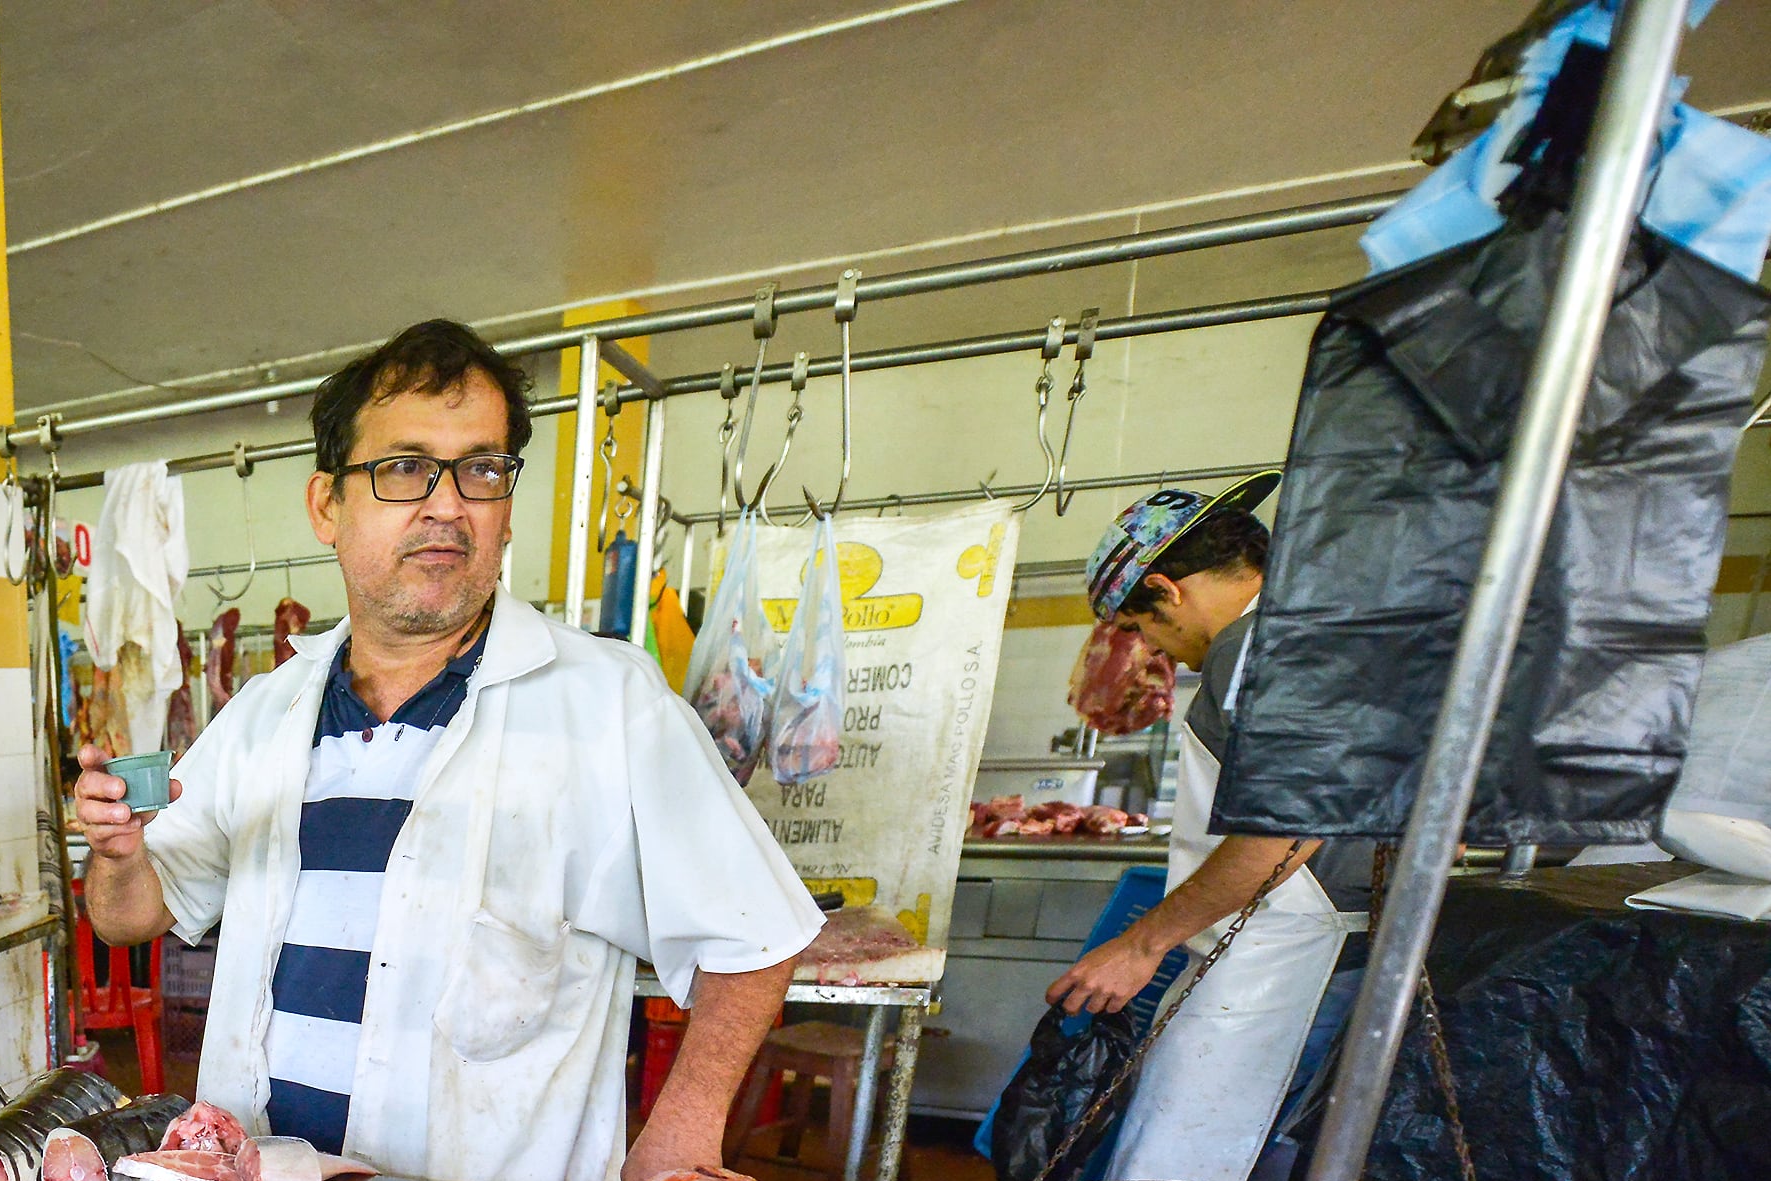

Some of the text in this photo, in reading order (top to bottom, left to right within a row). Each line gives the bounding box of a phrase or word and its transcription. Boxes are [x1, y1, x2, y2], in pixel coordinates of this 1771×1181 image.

[74, 523, 92, 567] 0
[928, 781, 953, 856] AVIDESA
[944, 742, 963, 781] MAC
[954, 677, 977, 737] POLLO
[780, 782, 828, 808] PARA
[764, 818, 845, 845] ALIMENT
